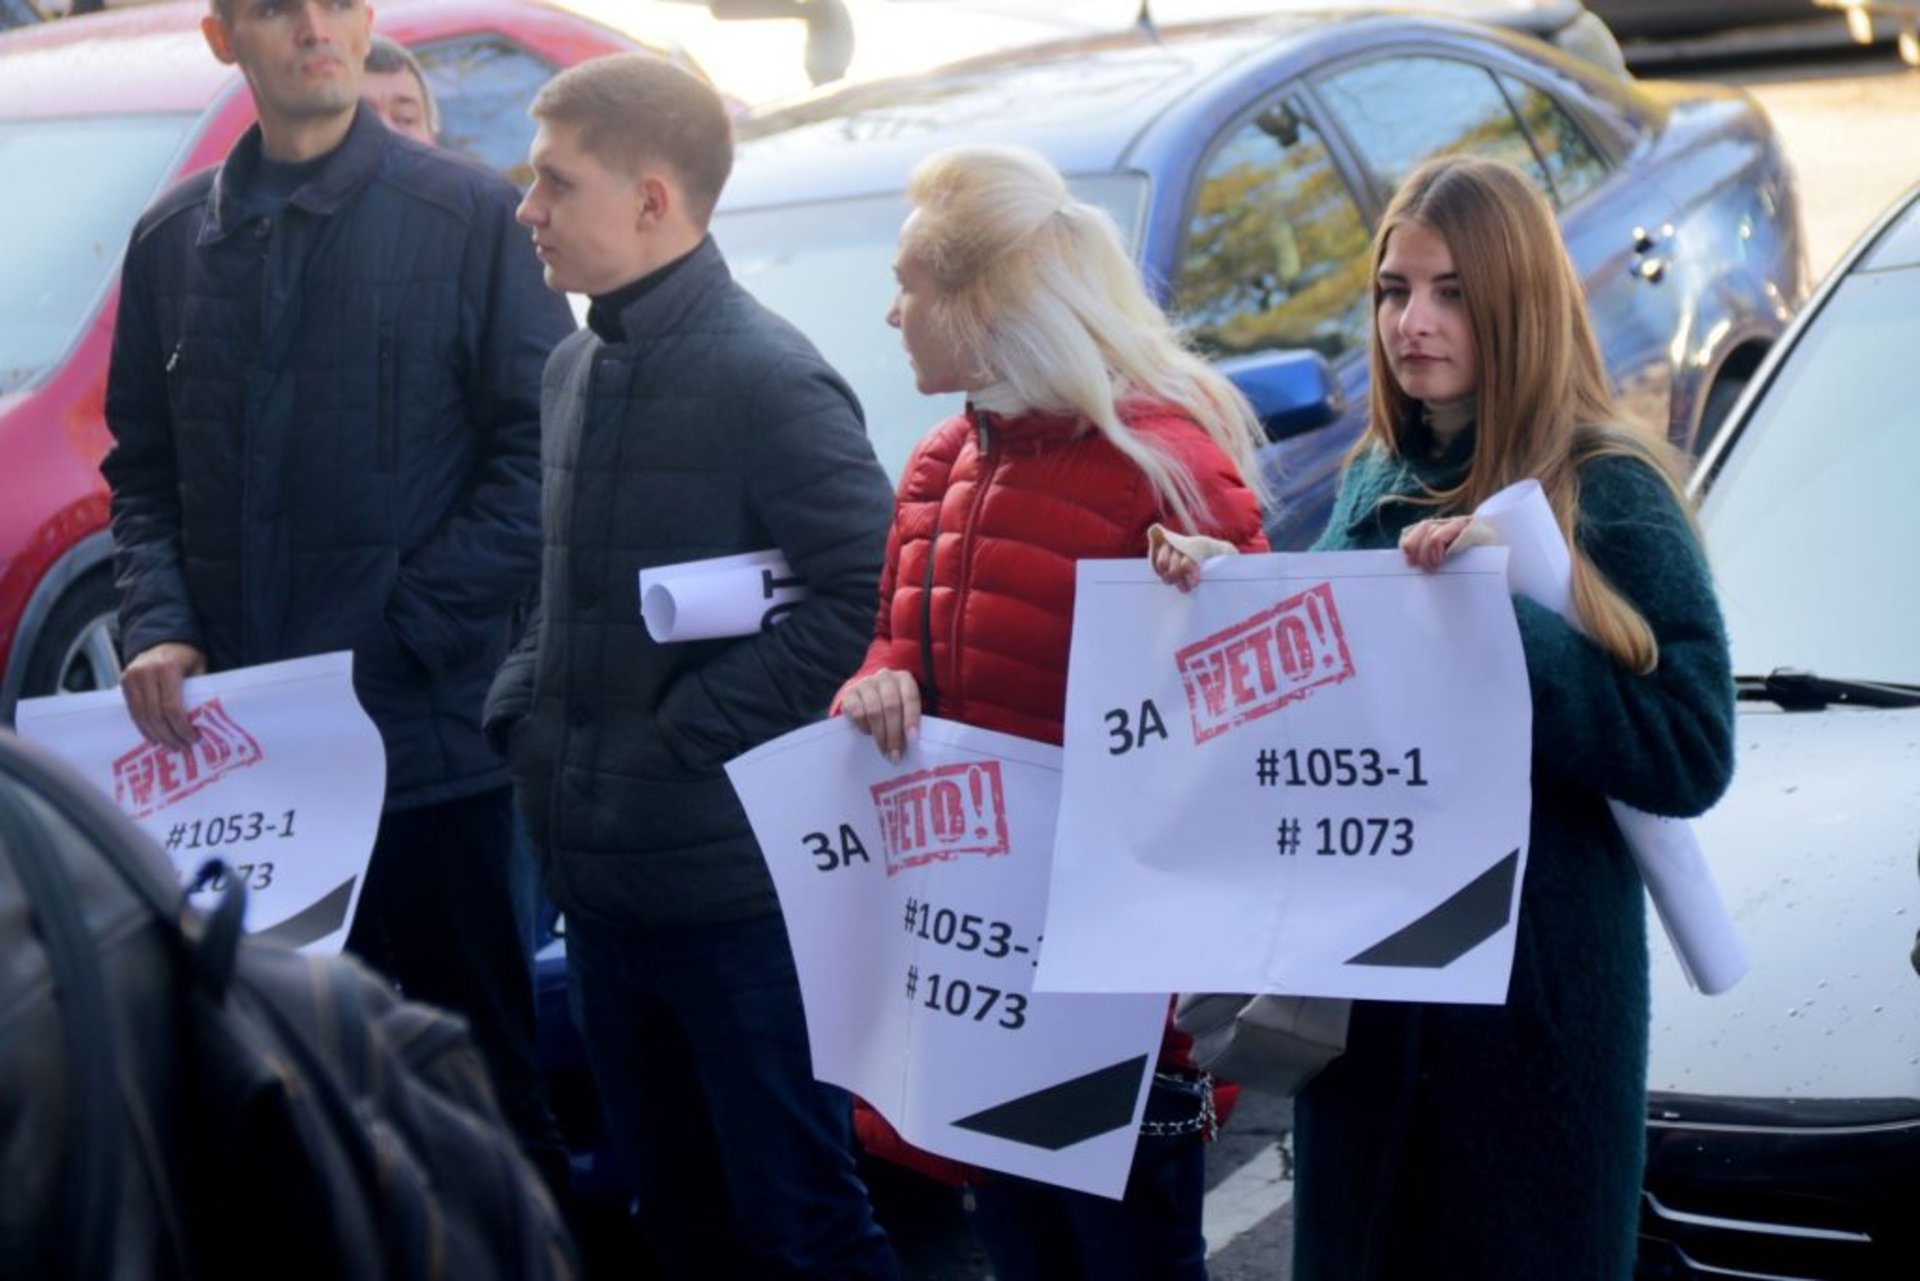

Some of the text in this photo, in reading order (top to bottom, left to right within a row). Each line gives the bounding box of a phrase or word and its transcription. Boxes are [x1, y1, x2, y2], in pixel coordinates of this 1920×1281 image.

[1103, 595, 1334, 755] ЗА VETO!
[1256, 747, 1428, 787] #1053-1
[166, 809, 295, 850] #1053-1
[802, 767, 989, 872] ЗА VETO!
[1277, 818, 1414, 857] # 1073
[906, 964, 1028, 1031] # 1073
